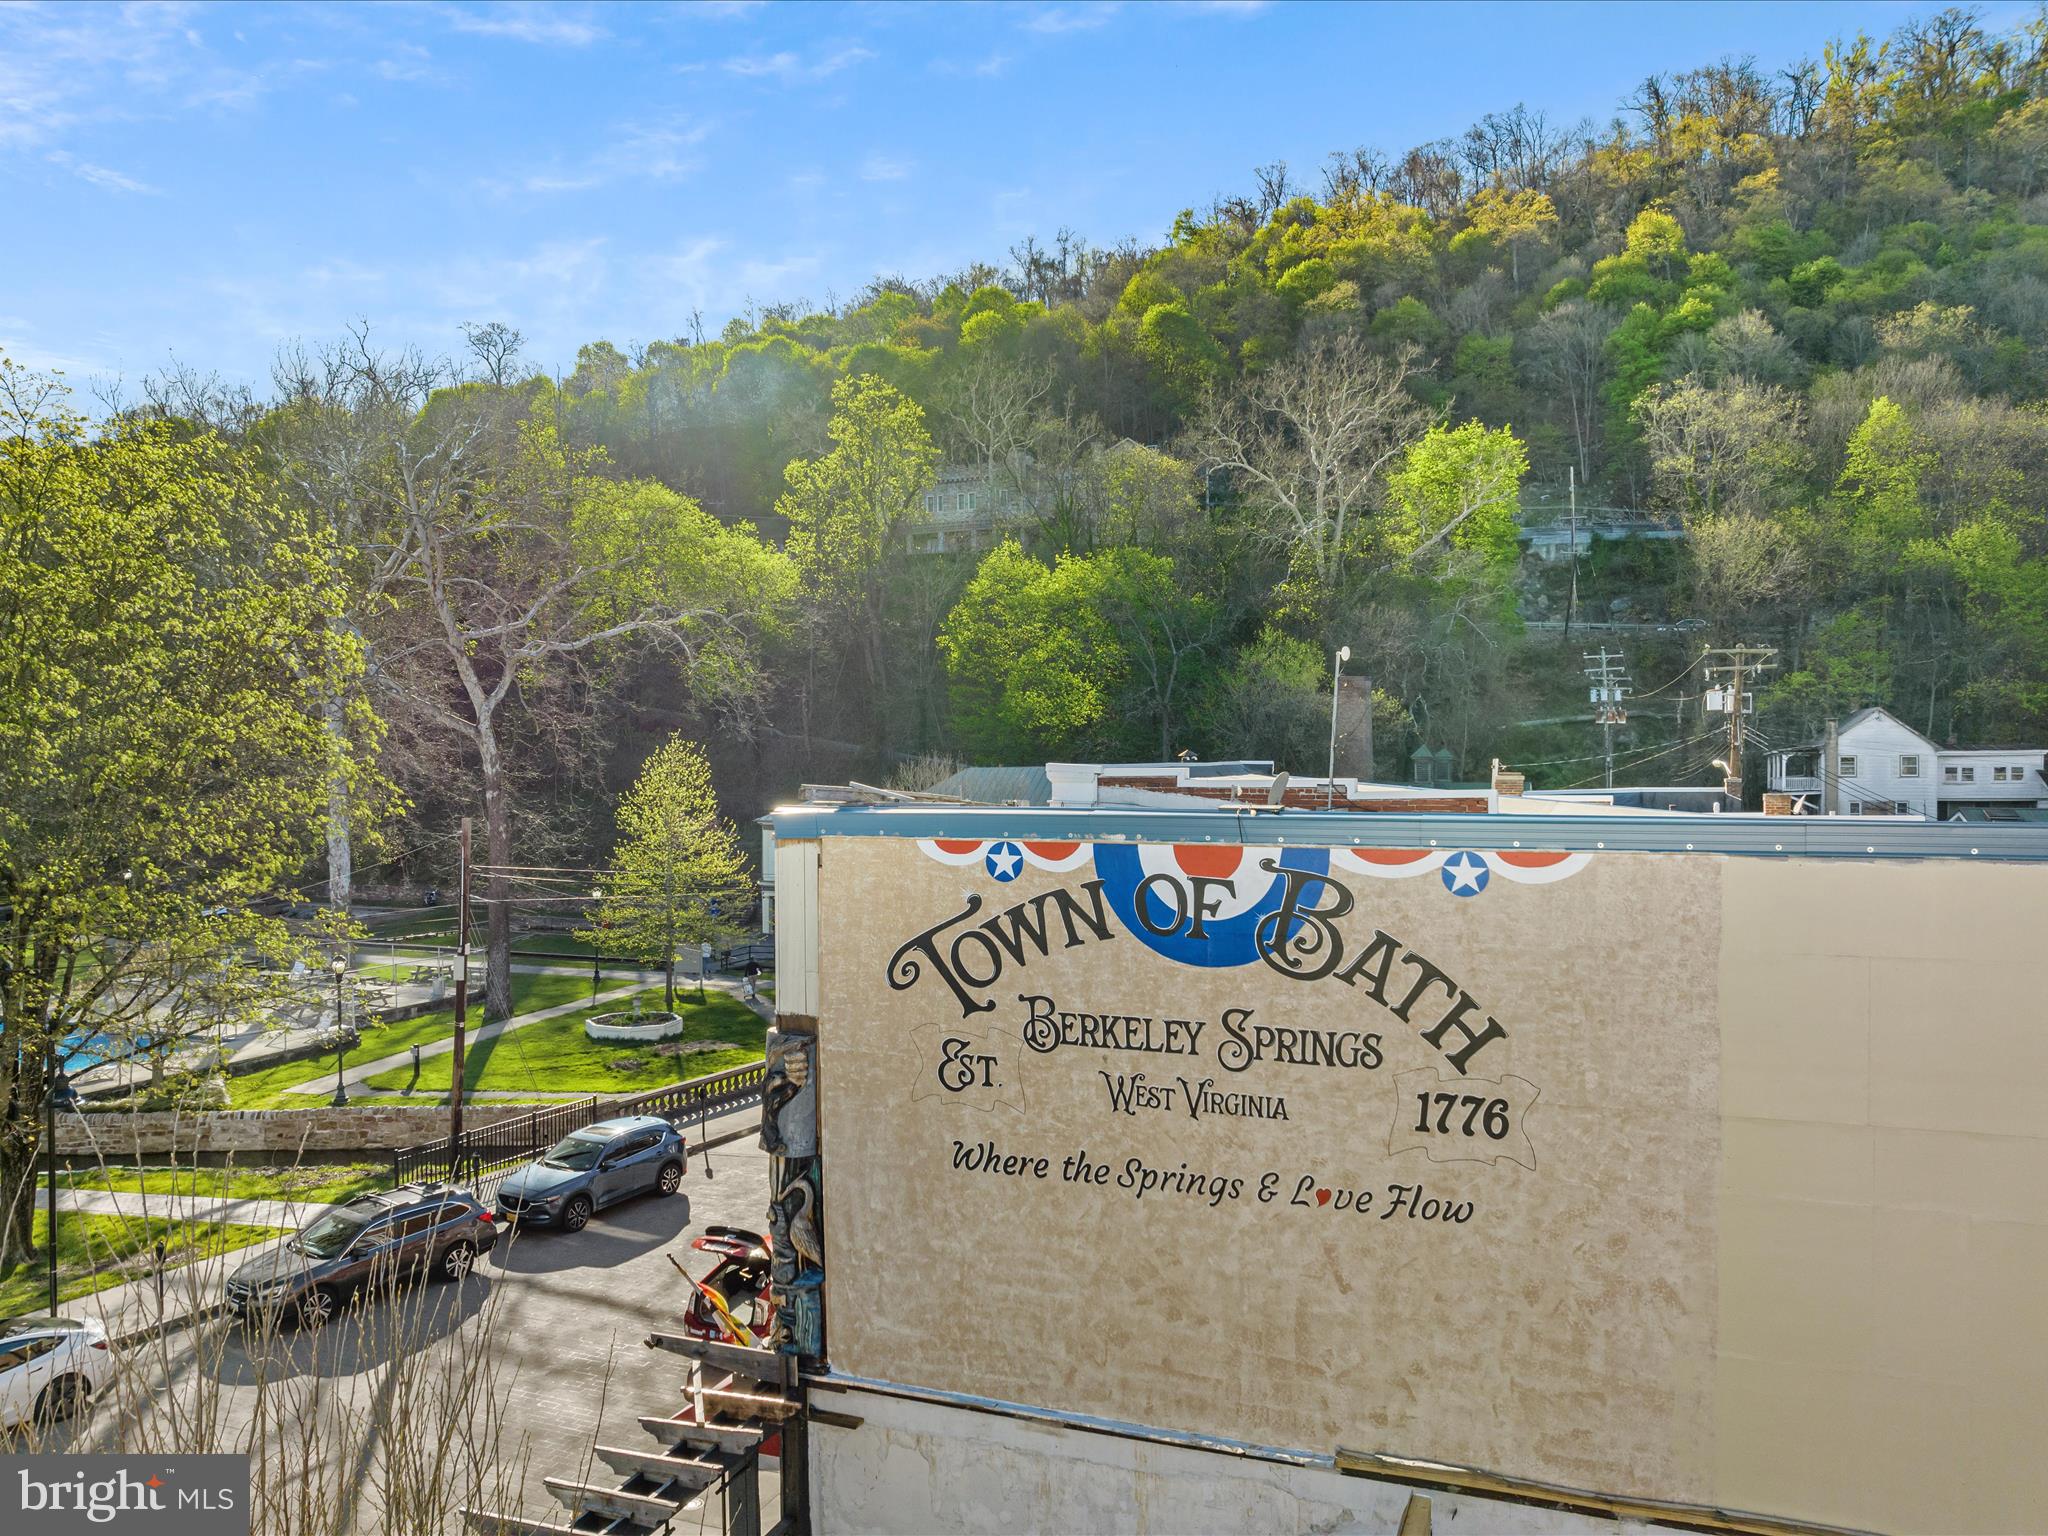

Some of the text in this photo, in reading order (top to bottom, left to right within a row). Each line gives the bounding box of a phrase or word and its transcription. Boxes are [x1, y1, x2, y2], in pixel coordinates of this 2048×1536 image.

[886, 857, 1510, 1077] TOWN OF BATH
[937, 1037, 1003, 1093] EST.
[1018, 993, 1384, 1073] BERKELEY SPRINGS
[1099, 1070, 1291, 1122] WEST VIRGINIA
[1414, 1091, 1511, 1141] 1776
[952, 1140, 1049, 1180] Where
[1062, 1150, 1110, 1185] the
[1117, 1158, 1245, 1207] Springs
[1257, 1172, 1279, 1202] &
[1380, 1184, 1475, 1225] Flow
